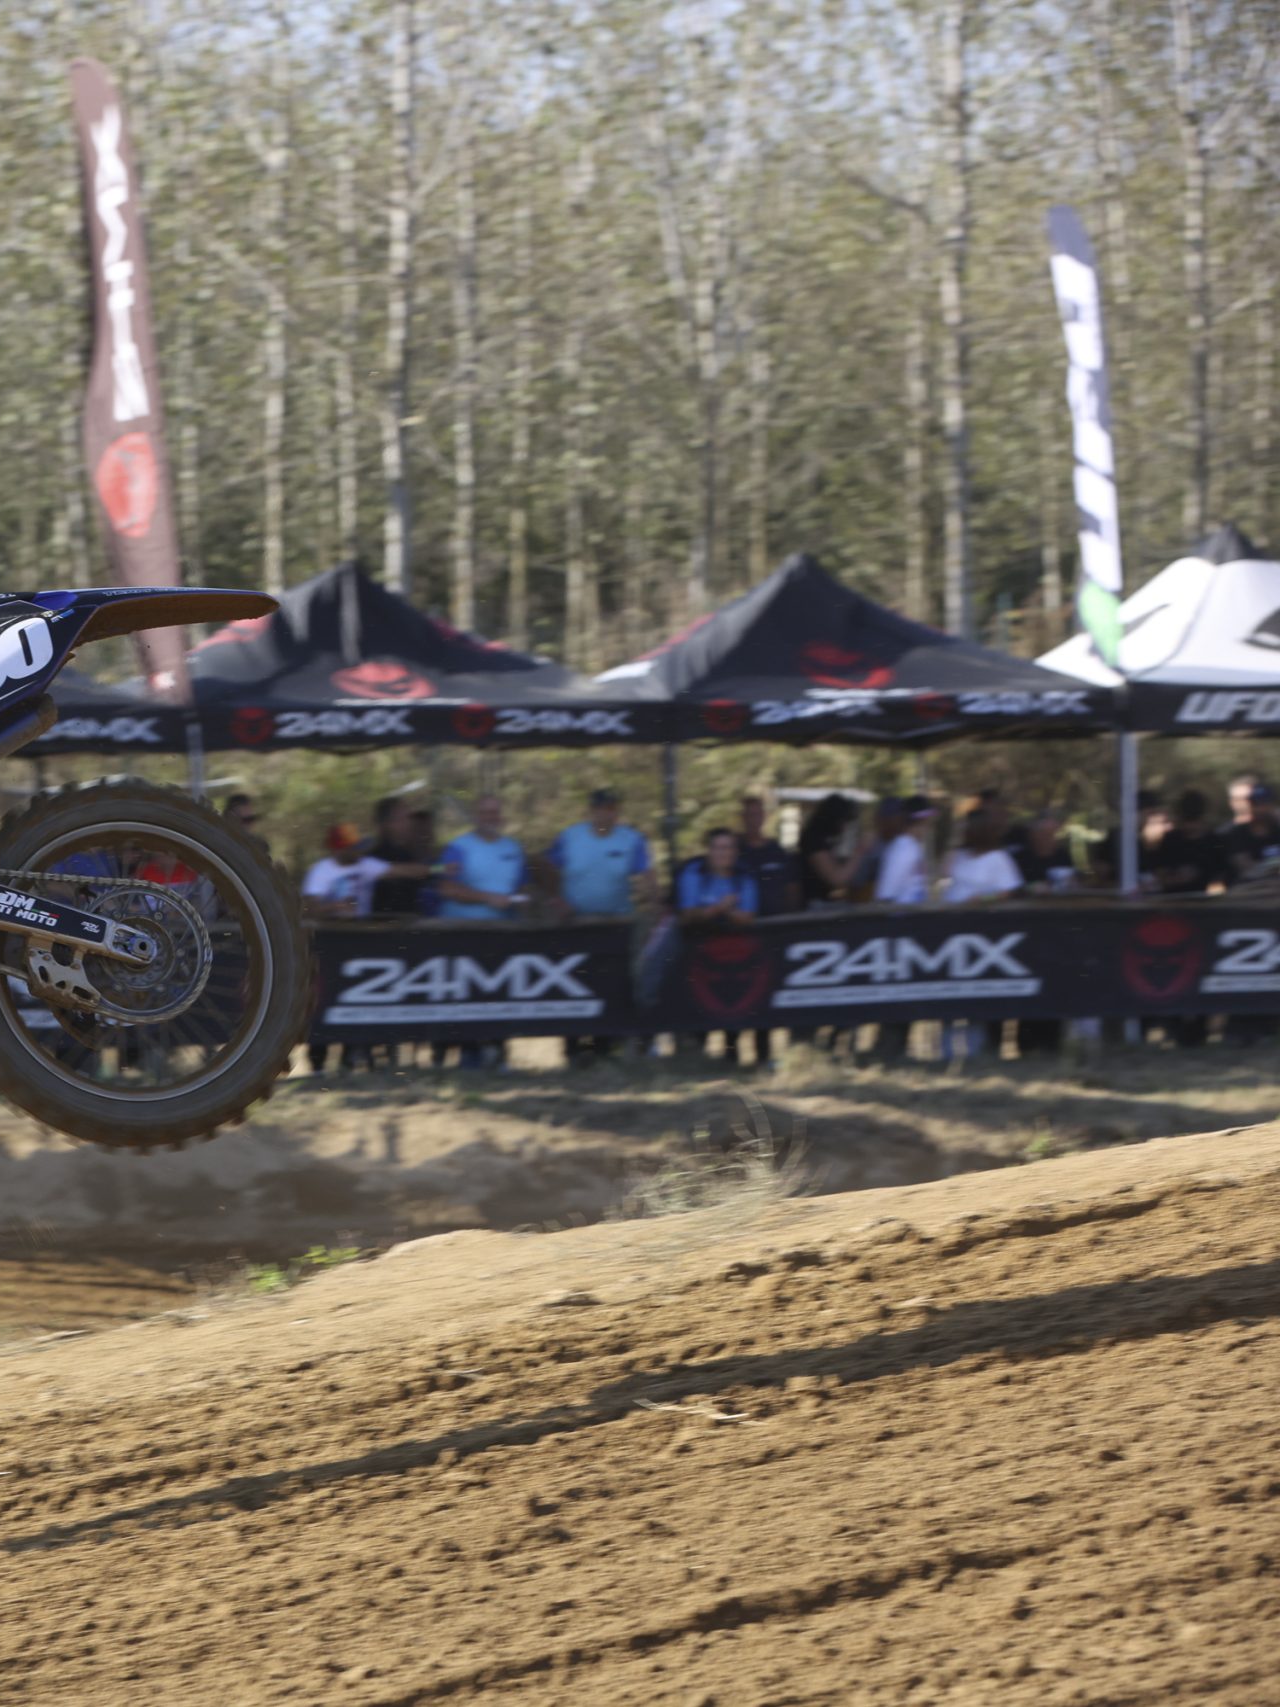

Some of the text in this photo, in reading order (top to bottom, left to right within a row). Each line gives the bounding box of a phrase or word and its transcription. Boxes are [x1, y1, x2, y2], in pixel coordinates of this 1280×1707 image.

[273, 708, 414, 738] 24MX
[491, 707, 634, 736] 24MX
[15, 909, 58, 927] MOTO
[783, 931, 1032, 986] 24MX
[335, 952, 596, 1004] 24MX
